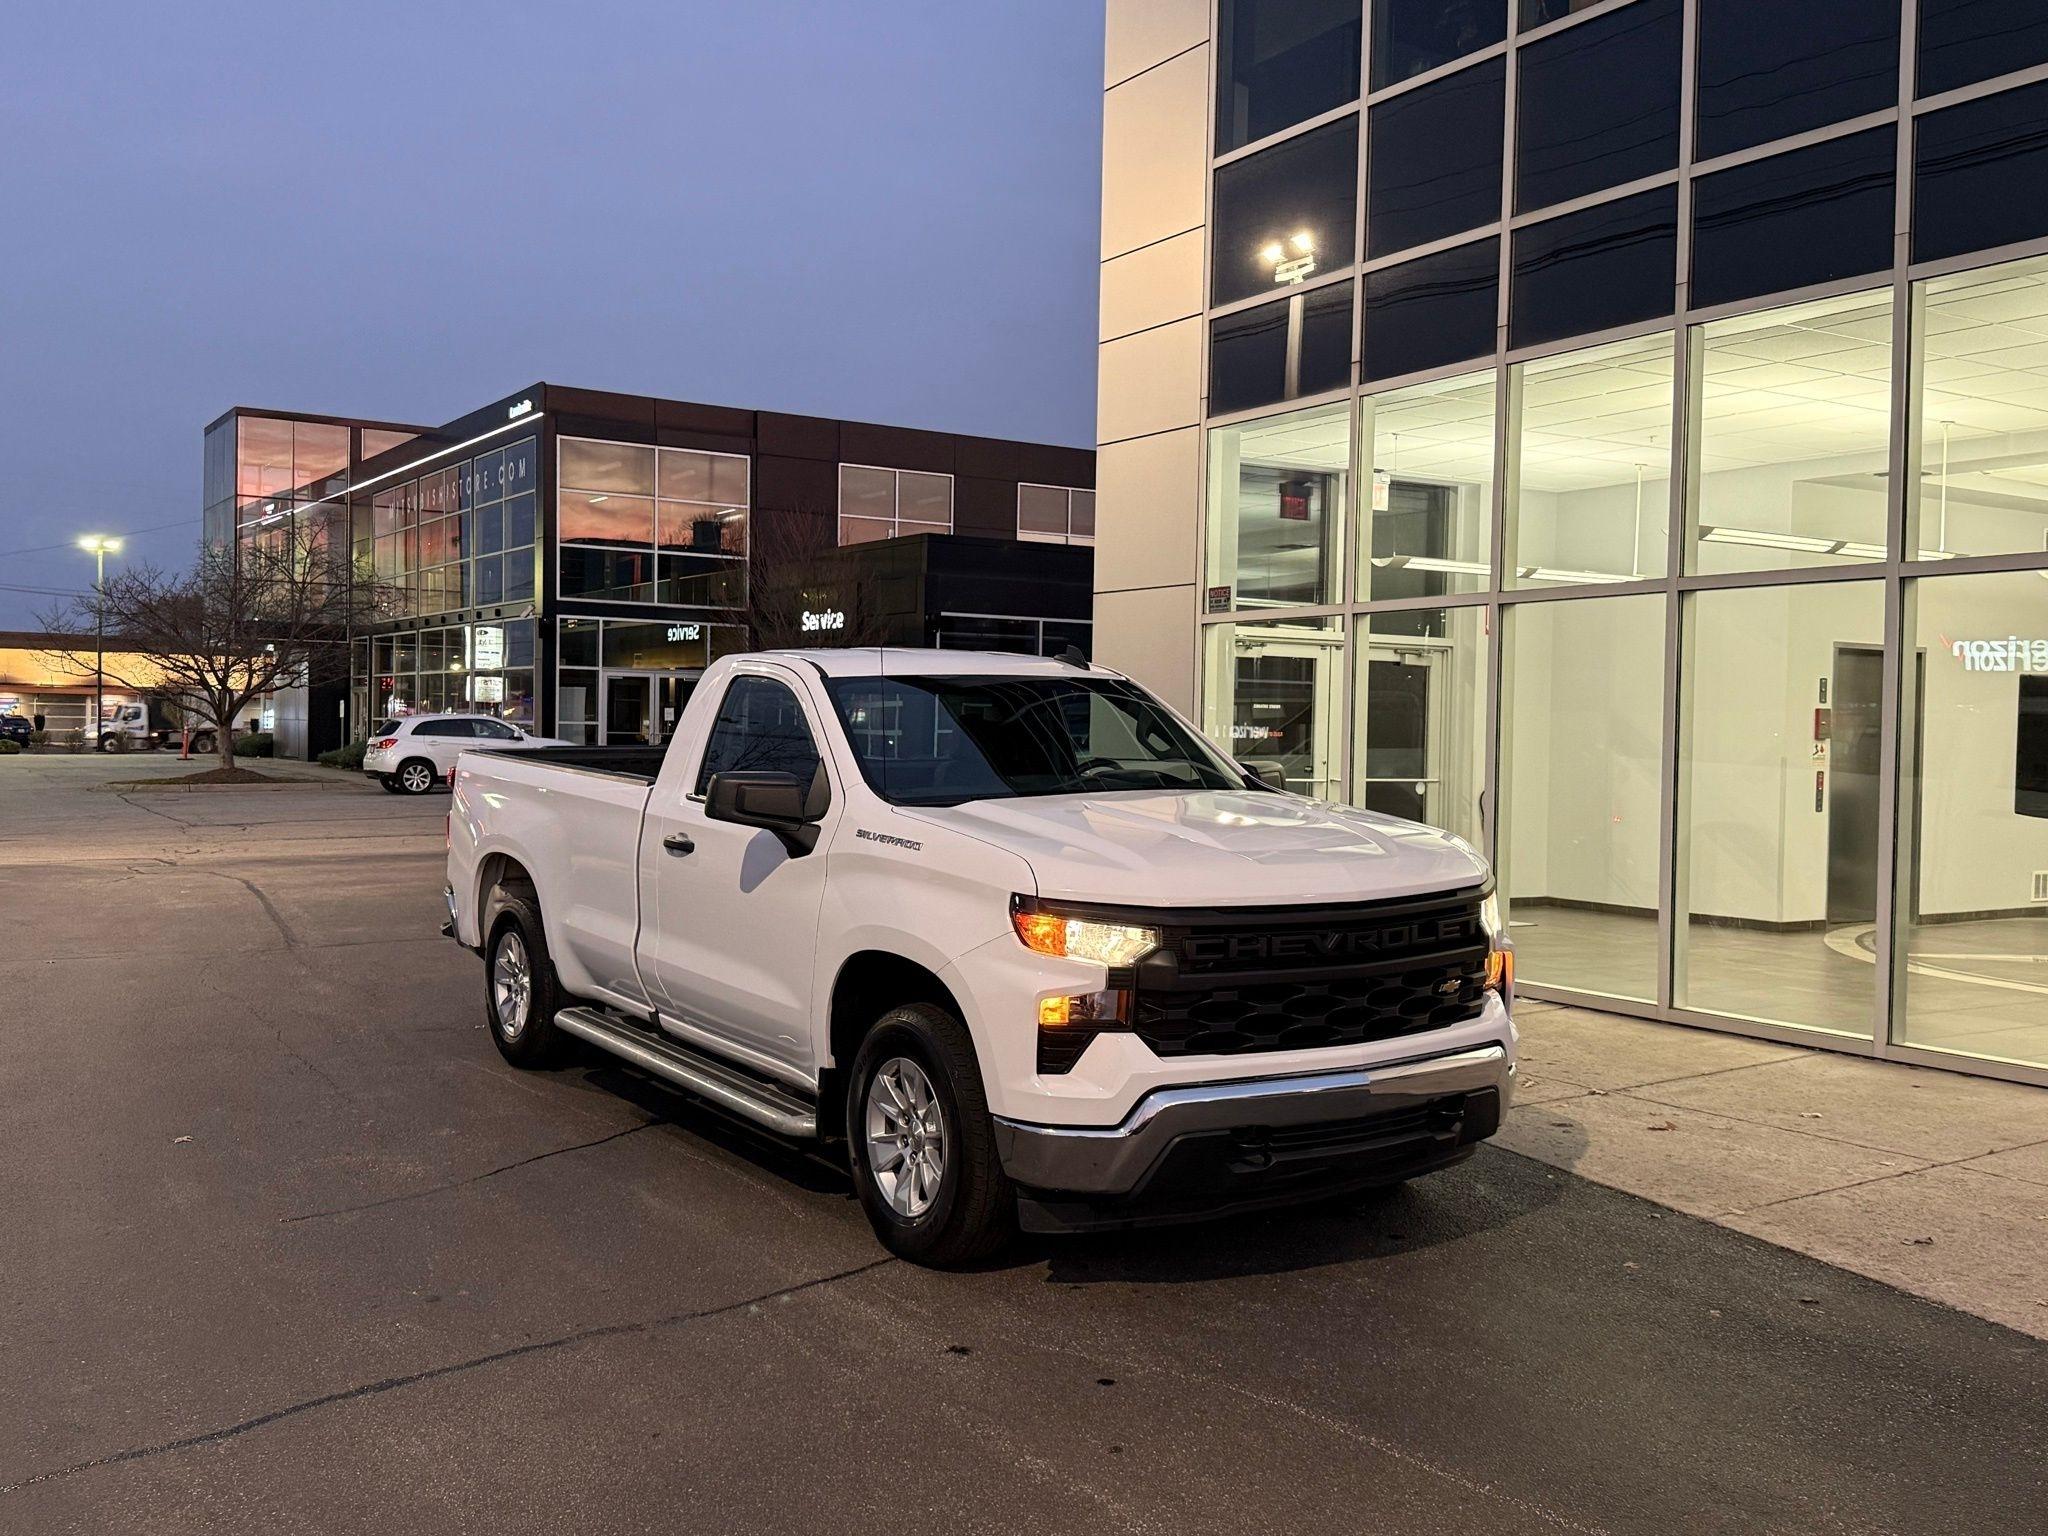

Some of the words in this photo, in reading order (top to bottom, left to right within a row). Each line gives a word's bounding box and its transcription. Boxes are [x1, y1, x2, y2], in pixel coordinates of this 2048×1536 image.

[802, 608, 844, 631] Service
[856, 828, 923, 851] SILVERADO
[1185, 915, 1483, 961] CHEVROLET
